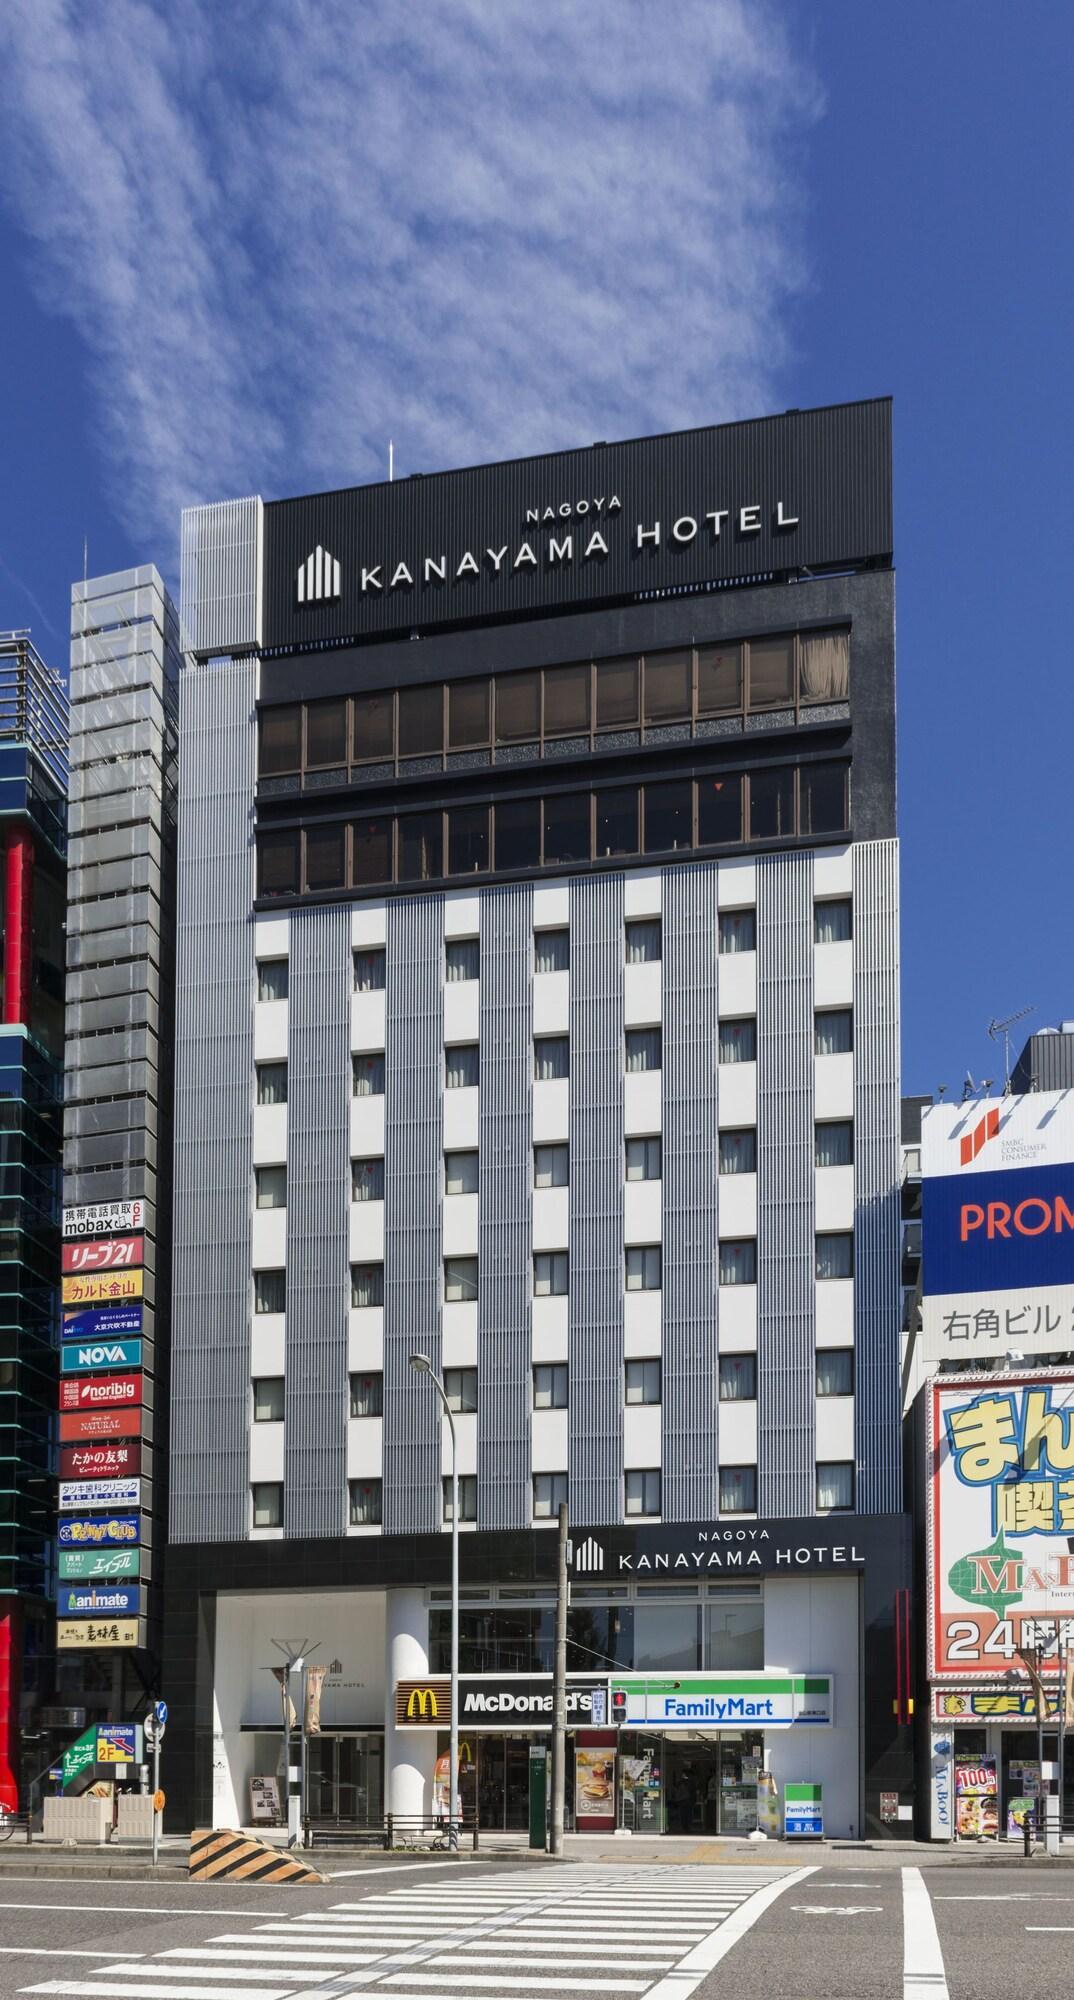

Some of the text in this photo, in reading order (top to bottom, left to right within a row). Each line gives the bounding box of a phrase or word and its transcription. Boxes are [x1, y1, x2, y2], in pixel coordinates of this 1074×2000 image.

[526, 495, 622, 523] NAGOYA
[360, 502, 799, 591] KANAYAMA HOTEL
[1001, 1151, 1037, 1161] FINANCE
[65, 1203, 131, 1222] 携帯電話買取
[65, 1219, 113, 1234] mobax
[72, 1241, 135, 1269] リーブ21
[72, 1280, 135, 1300] カルド金山
[943, 1304, 1061, 1341] 右角ビル
[79, 1346, 127, 1366] NOVA
[90, 1383, 135, 1397] noribig
[80, 1420, 121, 1431] NATURAL
[72, 1449, 128, 1465] たかの友梨
[108, 1520, 137, 1540] CLUB
[698, 1529, 770, 1541] NAGOYA
[618, 1546, 866, 1569] KANAYAMA HOTEL
[76, 1590, 129, 1607] animate
[464, 1692, 592, 1711] McDonad's
[665, 1698, 773, 1719] FamilyMart
[98, 1747, 114, 1761] 2F
[935, 1766, 949, 1825] MABOO!
[786, 1806, 820, 1814] FamilyMart
